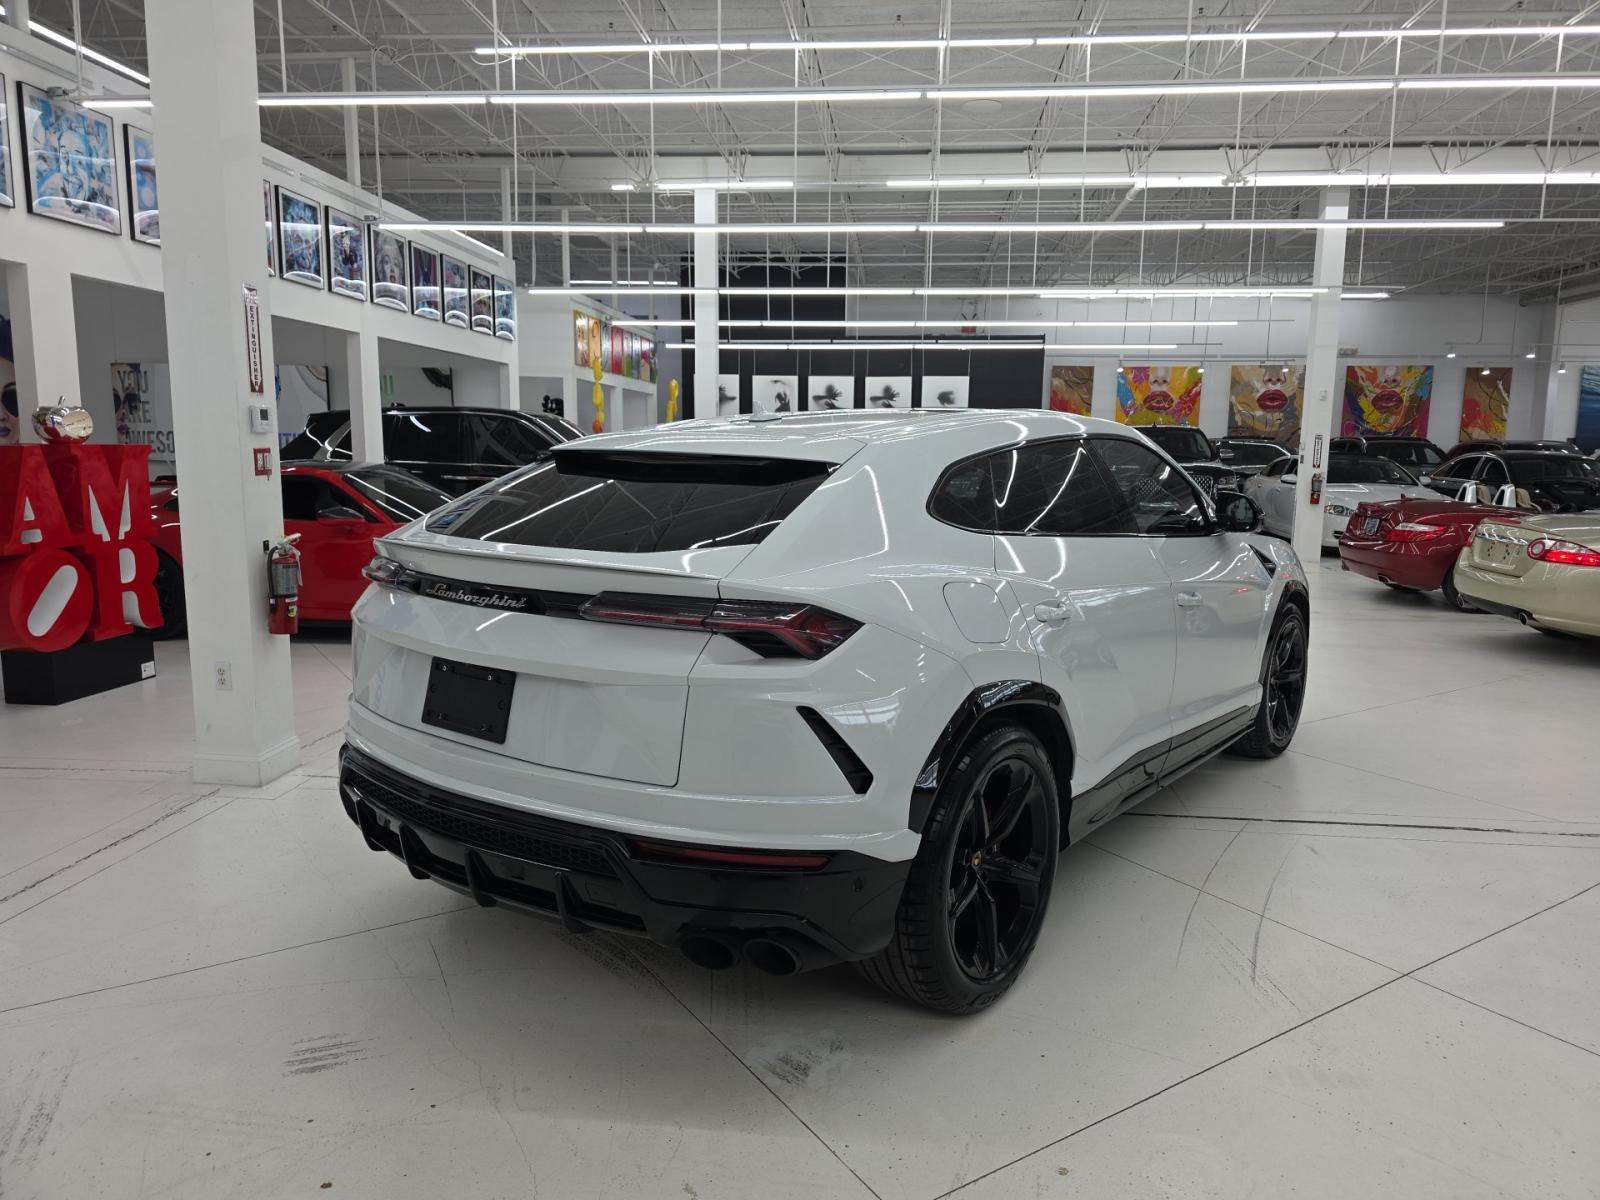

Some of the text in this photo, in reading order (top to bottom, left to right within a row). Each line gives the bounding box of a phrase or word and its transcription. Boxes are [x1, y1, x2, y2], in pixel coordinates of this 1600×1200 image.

[249, 305, 259, 386] EXTINGUISHER
[116, 369, 150, 394] YOU
[426, 583, 527, 608] Lamborghini
